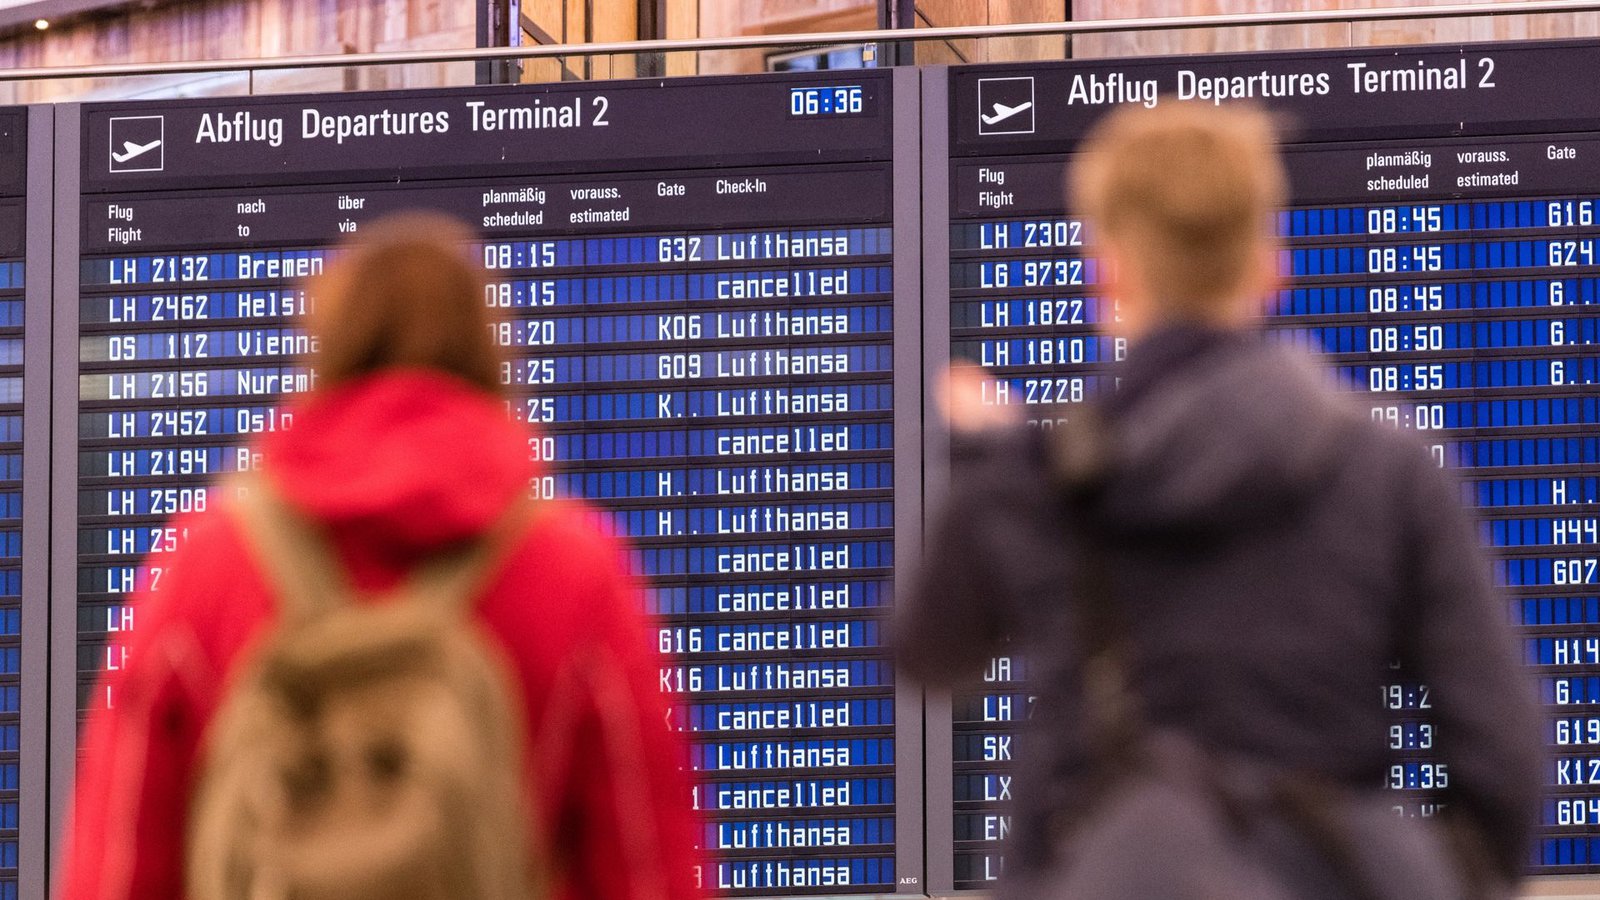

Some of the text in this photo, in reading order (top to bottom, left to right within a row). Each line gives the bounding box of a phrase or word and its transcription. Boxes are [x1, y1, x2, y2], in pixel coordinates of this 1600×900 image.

[792, 89, 862, 115] 06:36
[1068, 58, 1495, 109] Abflug Departures Terminal 2
[196, 96, 608, 146] Abflug Departures Terminal 2
[979, 146, 1575, 185] Flug planmäßig vorauss. Gate
[109, 179, 766, 221] Flug nach über planmäßig vorauss. Gate Check-In
[980, 171, 1518, 208] Flight scheduled estimated
[109, 207, 629, 244] Flight to via scheduled estimated
[981, 202, 1592, 249] LH 2302 08:45 G16
[110, 234, 847, 284] LH 2132 Bremen 08:15 G32 Lufthansa
[981, 241, 1592, 288] LG 9732 08:45 G24
[110, 273, 847, 322] LH 2462 Helsi 08:15 cancelled
[982, 282, 1589, 327] LH 1822 08:45 G..
[109, 337, 135, 360] OS
[169, 334, 207, 358] 112
[659, 316, 700, 340] K06
[718, 313, 847, 338] Lufthansa
[982, 322, 1590, 366] LH 1810 08:50 G..
[109, 375, 135, 399] LH
[152, 373, 207, 398] 2156
[659, 355, 700, 379] G09
[718, 352, 847, 377] Lufthansa
[982, 361, 1590, 405] LH 2228 08:55 G..
[109, 414, 134, 438] LH
[152, 411, 206, 436] 2452
[238, 409, 292, 433] Oslo
[659, 394, 696, 418] K..
[718, 391, 847, 416] Lufthansa
[1372, 405, 1443, 430] 09:00
[109, 452, 134, 477] LH
[151, 450, 206, 475] 2194
[718, 430, 848, 455] cancelled
[108, 491, 134, 515] LH
[151, 489, 206, 514] 2508
[659, 473, 696, 496] H..
[718, 469, 847, 494] Lufthansa
[1553, 480, 1592, 505] H..
[108, 530, 134, 554] LH
[659, 512, 697, 535] H..
[719, 508, 848, 533] Lufthansa
[1554, 520, 1597, 545] H44
[108, 569, 134, 593] LH
[719, 547, 848, 573] cancelled
[1554, 560, 1597, 585] G07
[108, 586, 848, 631] LH cancelled
[660, 629, 701, 653] G16
[719, 625, 848, 651] cancelled
[1555, 640, 1599, 665] H14
[660, 665, 848, 692] K16 Lufthansa
[719, 703, 848, 730] cancelled
[984, 697, 1010, 721] LH
[1556, 681, 1595, 705] G..
[719, 744, 849, 770] Lufthansa
[984, 737, 1010, 761] SK
[1557, 720, 1600, 745] G19
[719, 782, 849, 809] cancelled
[985, 760, 1600, 800] LX 9:35 K12
[719, 823, 849, 848] Lufthansa
[985, 800, 1600, 840] EN G04
[719, 863, 849, 888] Lufthansa
